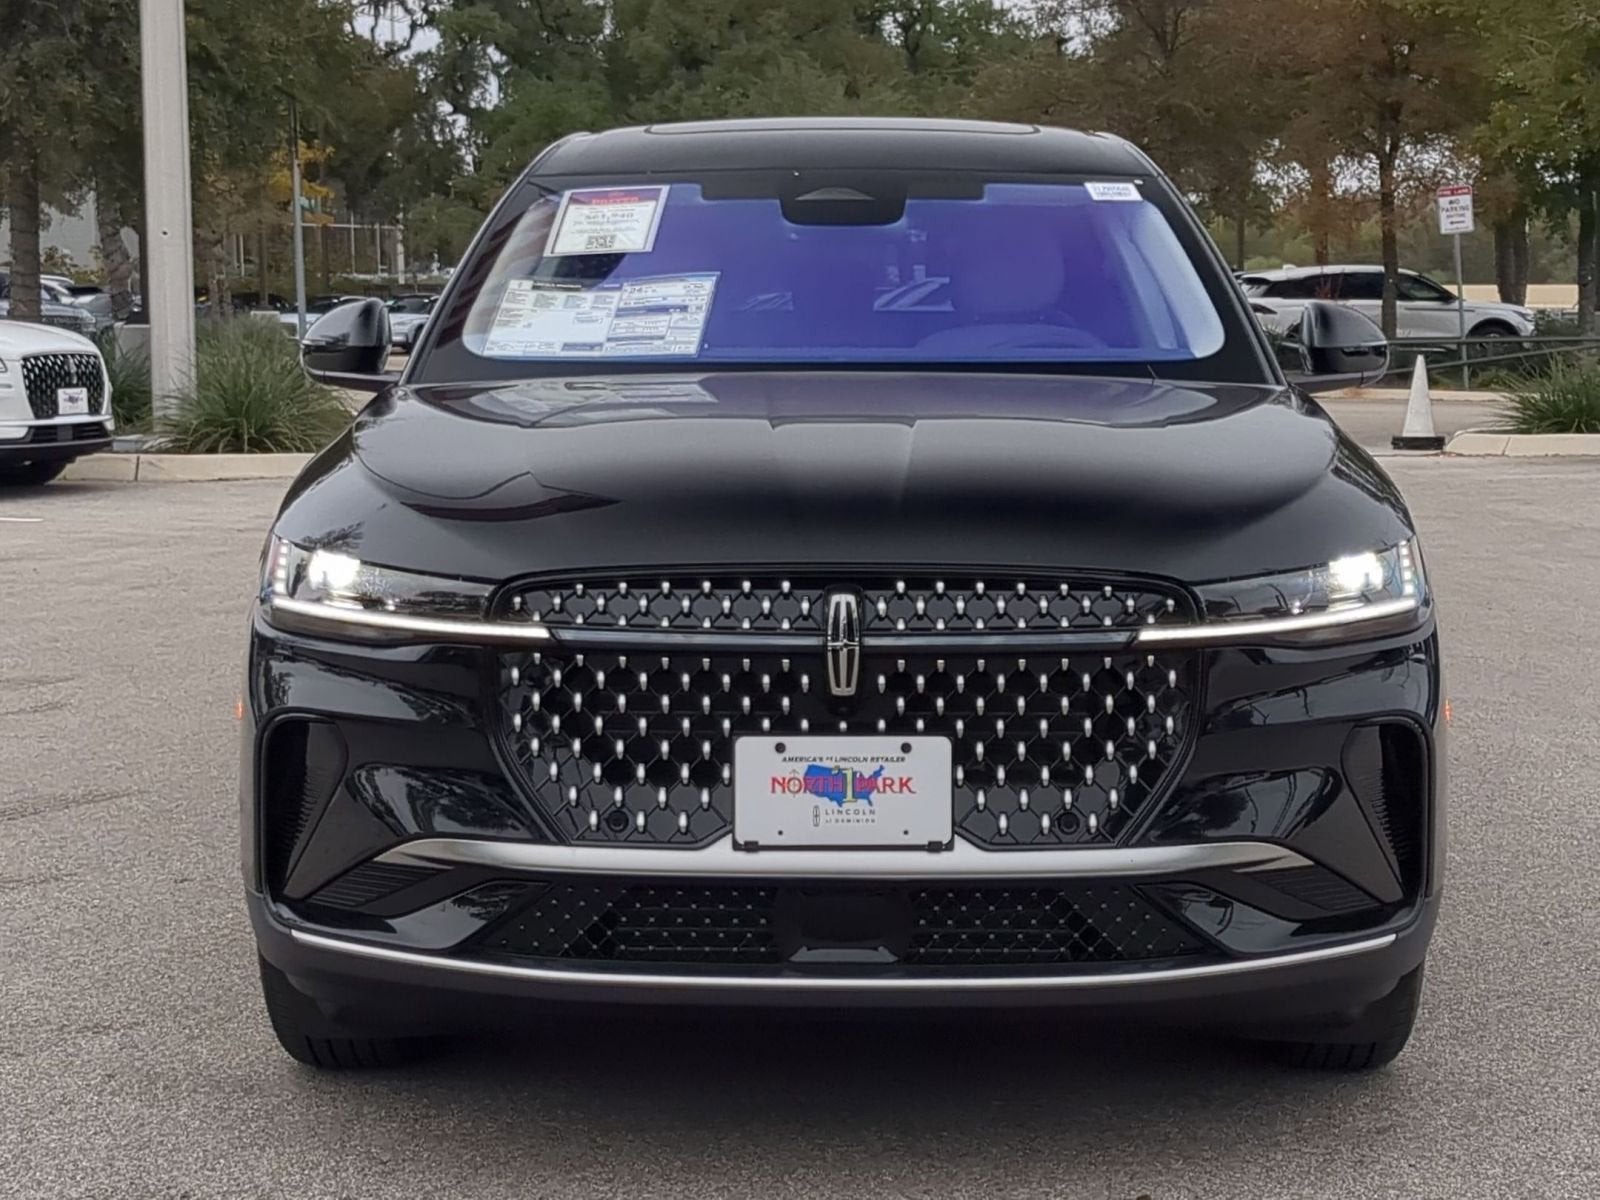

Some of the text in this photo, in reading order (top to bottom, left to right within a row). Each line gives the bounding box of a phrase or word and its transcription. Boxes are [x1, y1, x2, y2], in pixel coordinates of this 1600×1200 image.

[771, 776, 843, 794] NORTH
[856, 776, 917, 794] PARK
[825, 808, 876, 816] LINCOLN
